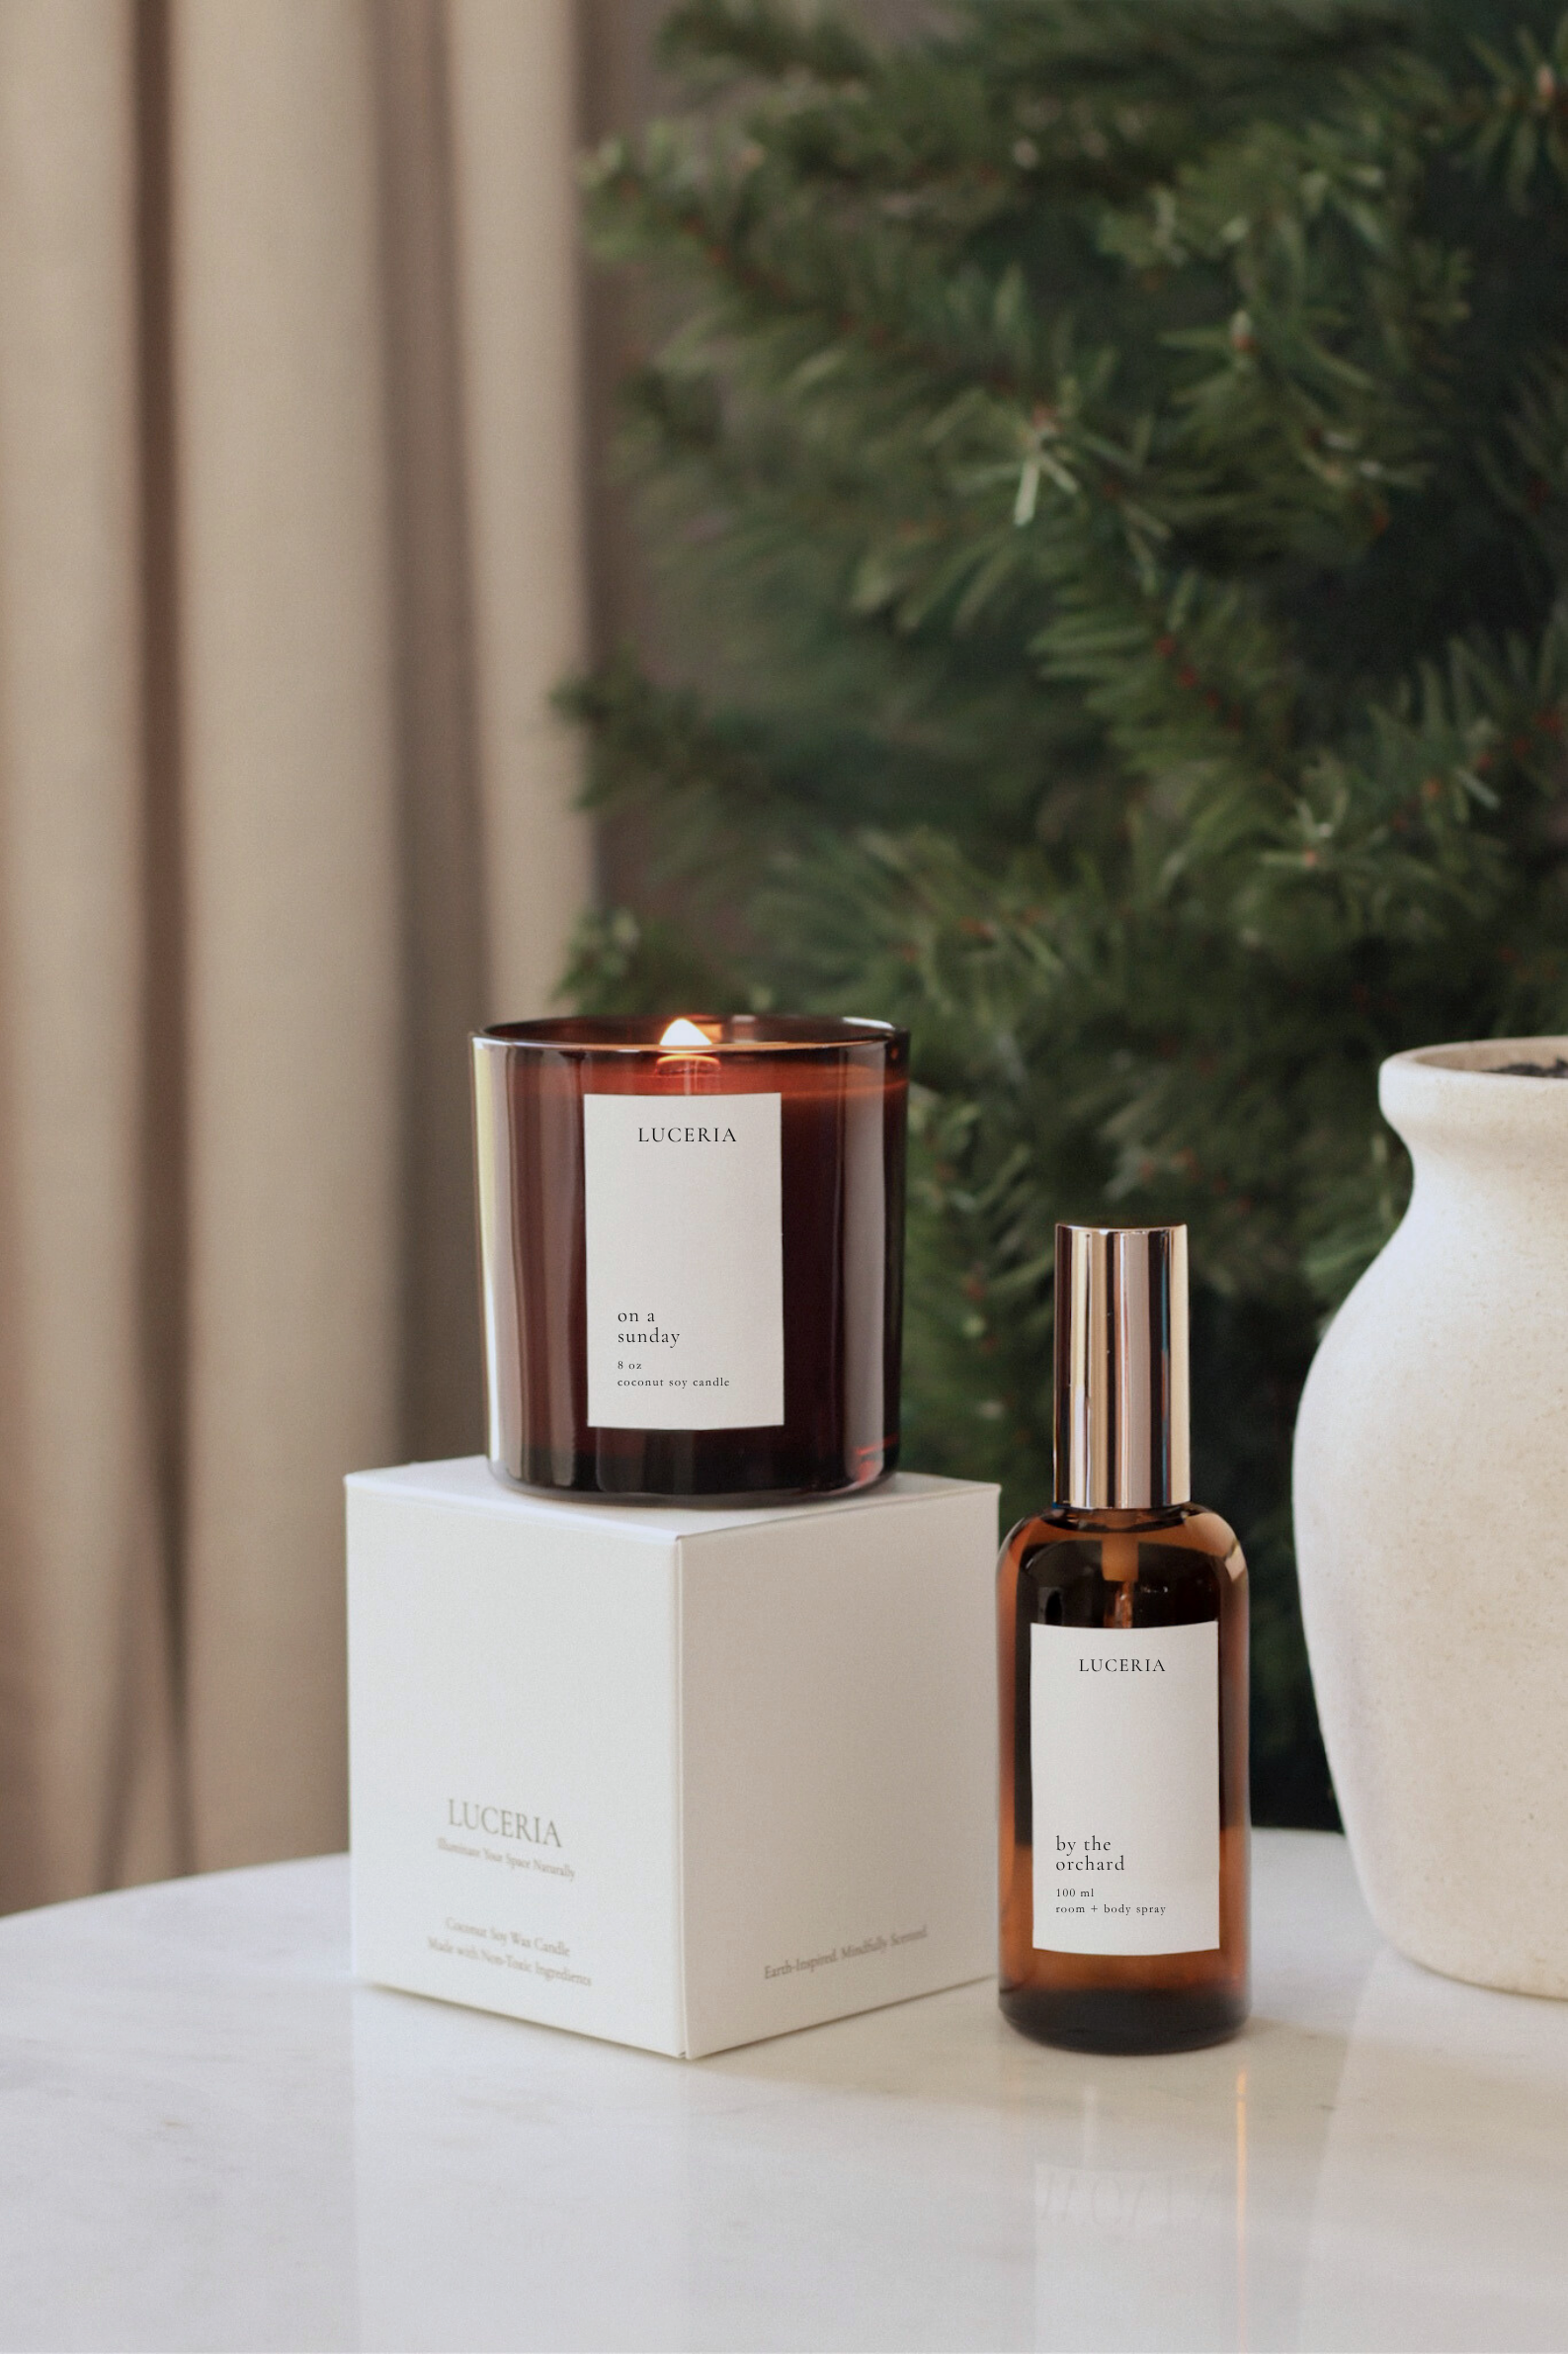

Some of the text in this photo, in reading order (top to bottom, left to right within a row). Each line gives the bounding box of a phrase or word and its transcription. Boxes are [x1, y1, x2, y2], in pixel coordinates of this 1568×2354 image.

[637, 1127, 738, 1142] LUCERIA
[617, 1310, 655, 1322] on a
[617, 1327, 681, 1348] sunday
[618, 1360, 623, 1370] 8
[617, 1377, 730, 1388] coconut soy candle
[1079, 1658, 1166, 1672] LUCERIA
[449, 1798, 562, 1848] LUCERIA
[1055, 1834, 1112, 1856] by the
[483, 1847, 503, 1862] Your
[506, 1853, 531, 1870] Space
[534, 1859, 576, 1882] Naturally
[1055, 1855, 1125, 1871] orchard
[1055, 1888, 1094, 1897] 100 ml
[1104, 1903, 1131, 1916] body
[1135, 1905, 1167, 1916] spray
[489, 1925, 508, 1946] Soy
[510, 1931, 532, 1948] Wax
[534, 1937, 570, 1957] Candle
[427, 1936, 454, 1954] Made
[456, 1944, 479, 1960] with
[535, 1961, 592, 1986] Ingredients
